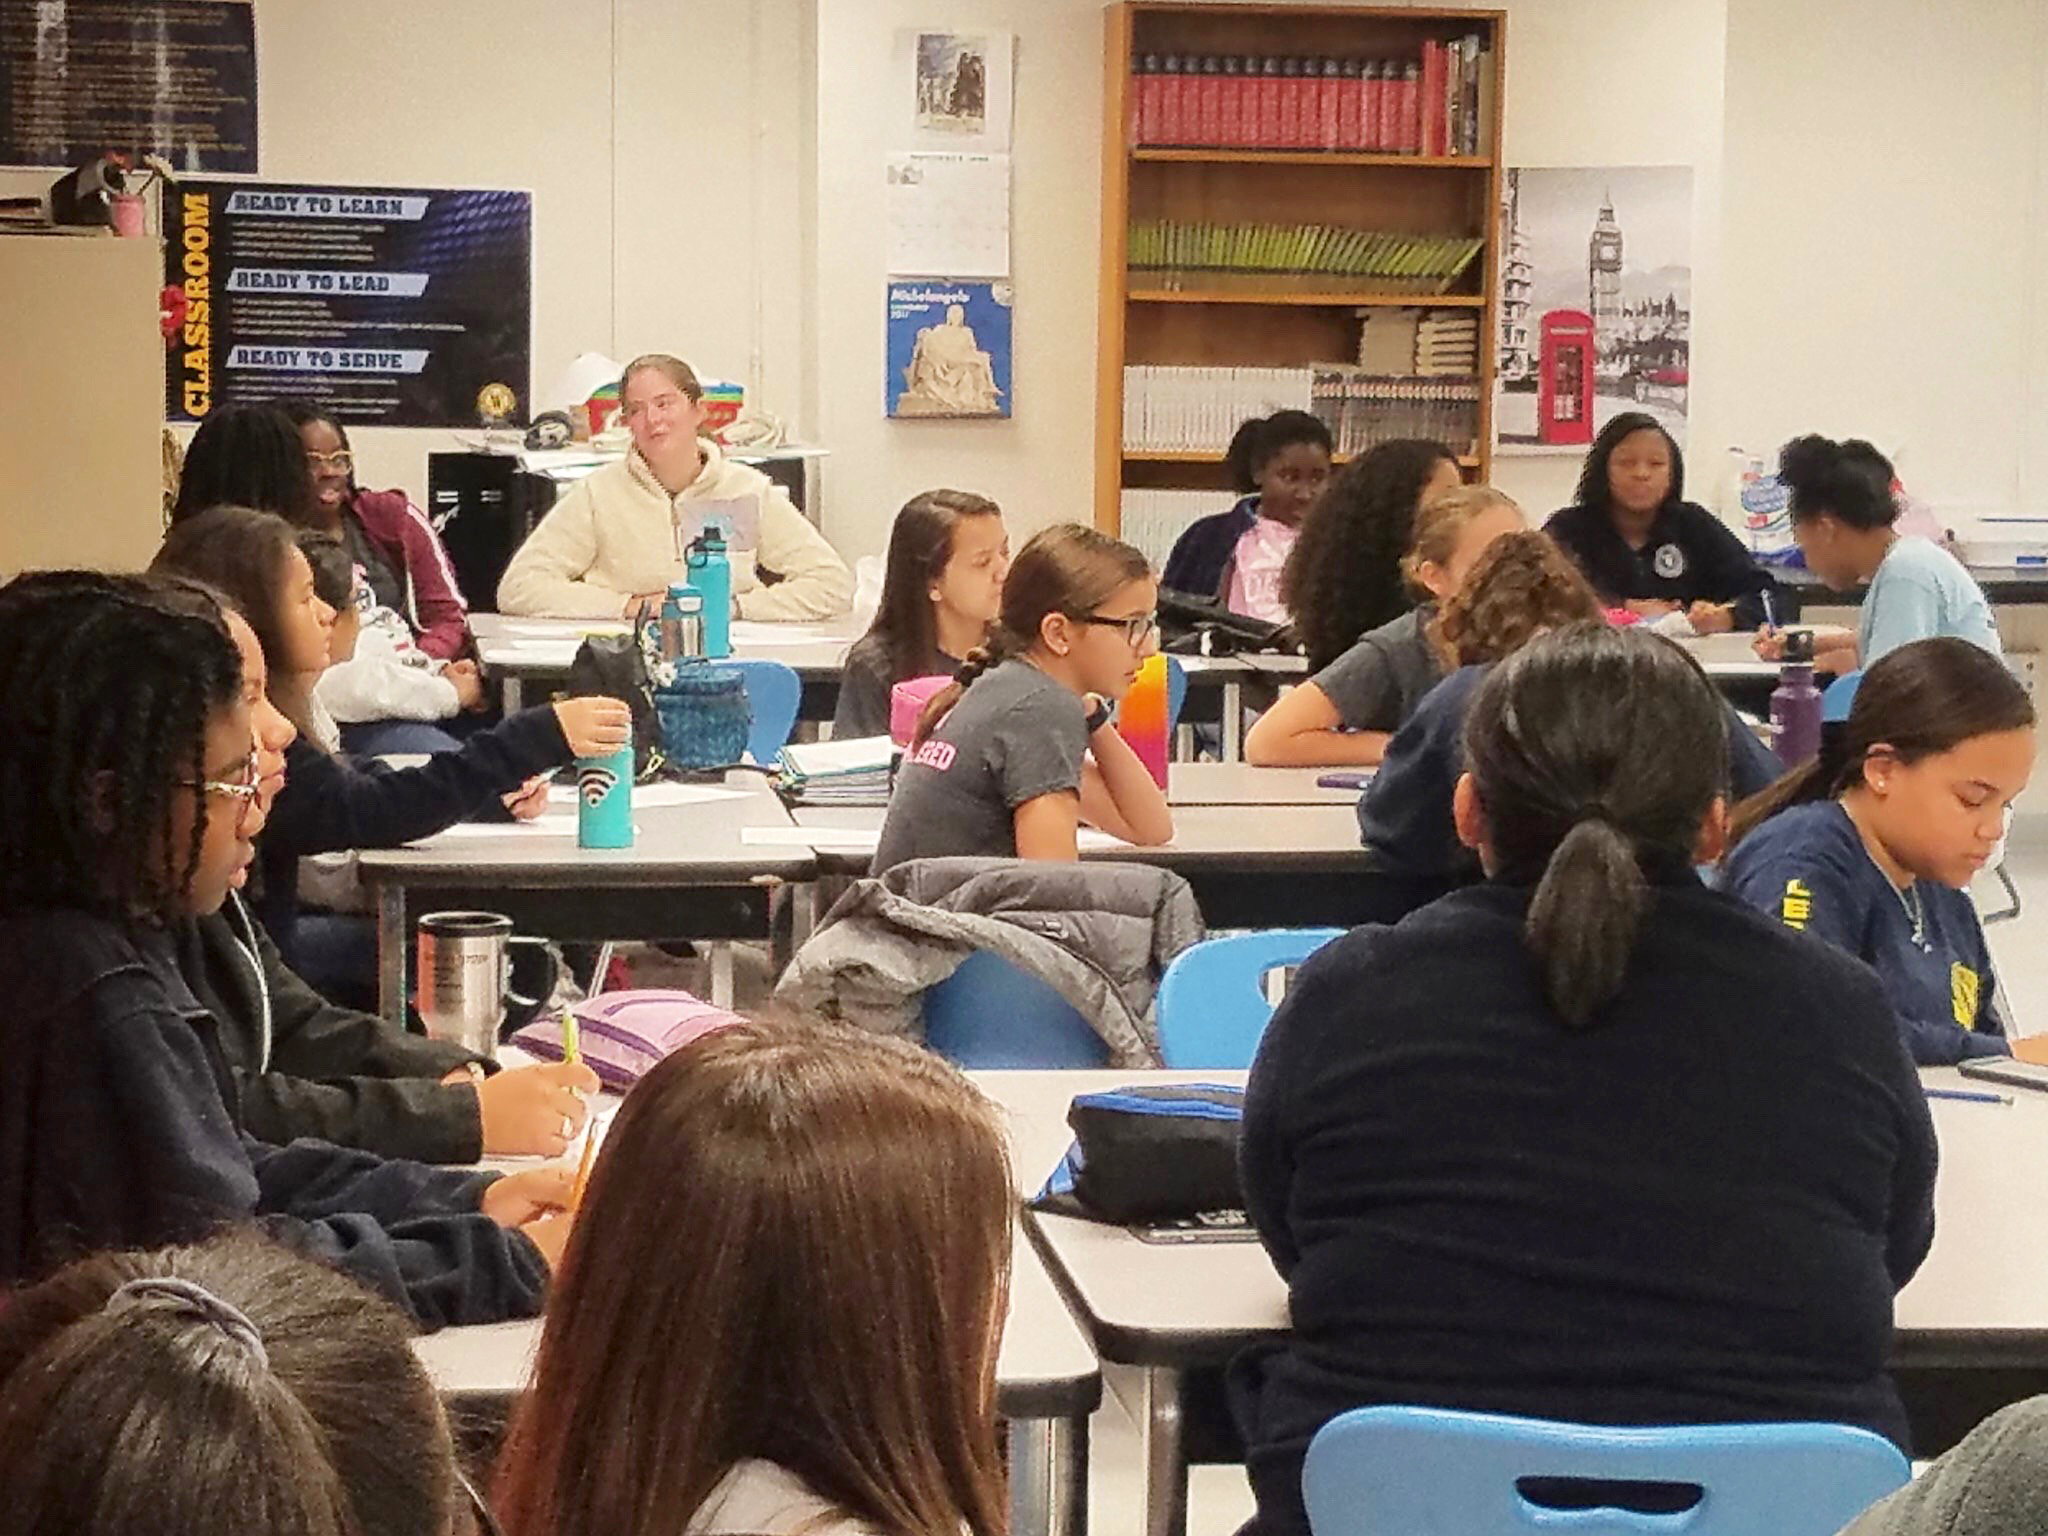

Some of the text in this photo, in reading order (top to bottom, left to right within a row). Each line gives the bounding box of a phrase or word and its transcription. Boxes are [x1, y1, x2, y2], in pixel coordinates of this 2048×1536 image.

[234, 194, 403, 215] READY TO LEARN
[236, 272, 389, 291] READY TO LEAD
[183, 193, 212, 416] CLASSROOM
[236, 350, 403, 369] READY TO SERVE
